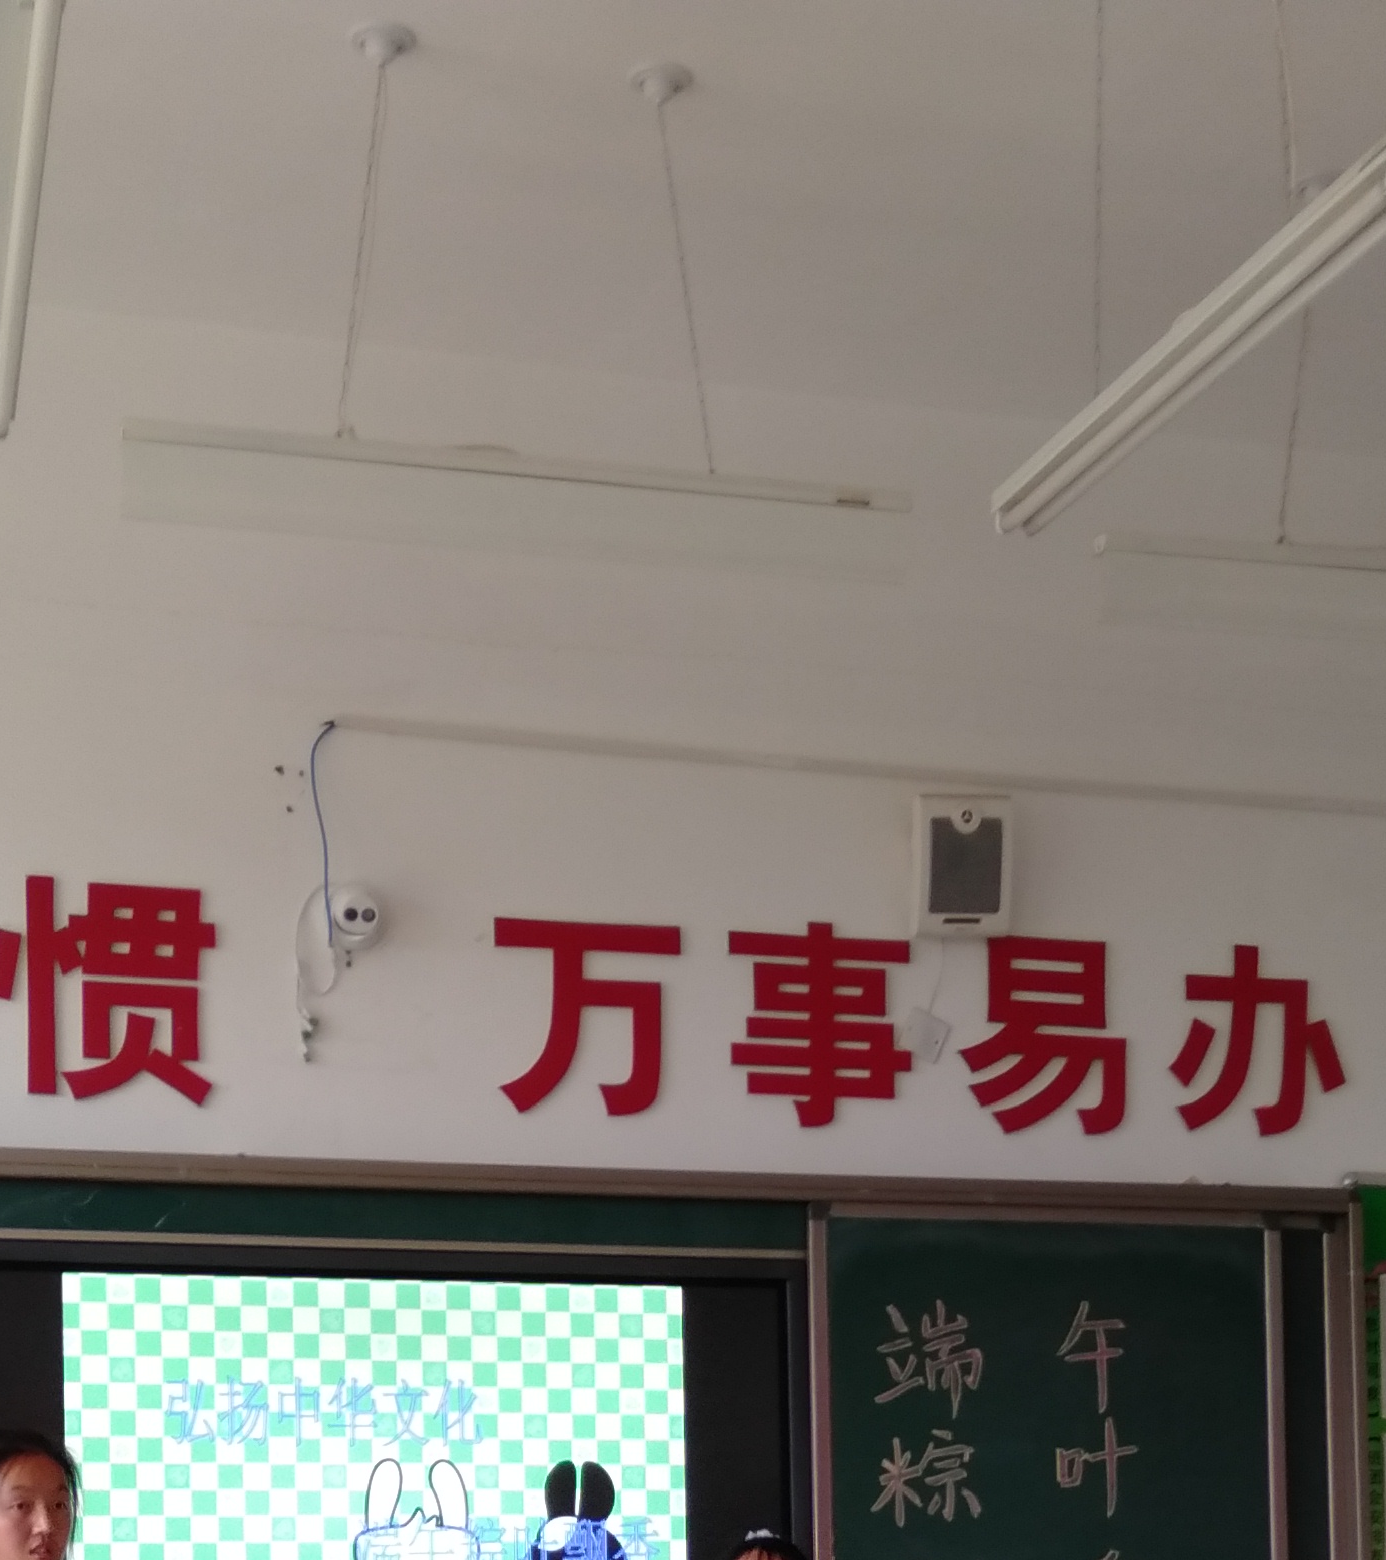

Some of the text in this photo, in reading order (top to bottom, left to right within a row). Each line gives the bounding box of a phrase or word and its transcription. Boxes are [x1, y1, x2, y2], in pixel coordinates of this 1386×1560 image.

[493, 916, 1347, 1137] 万事易办
[164, 1376, 485, 1448] 弘扬中华文化
